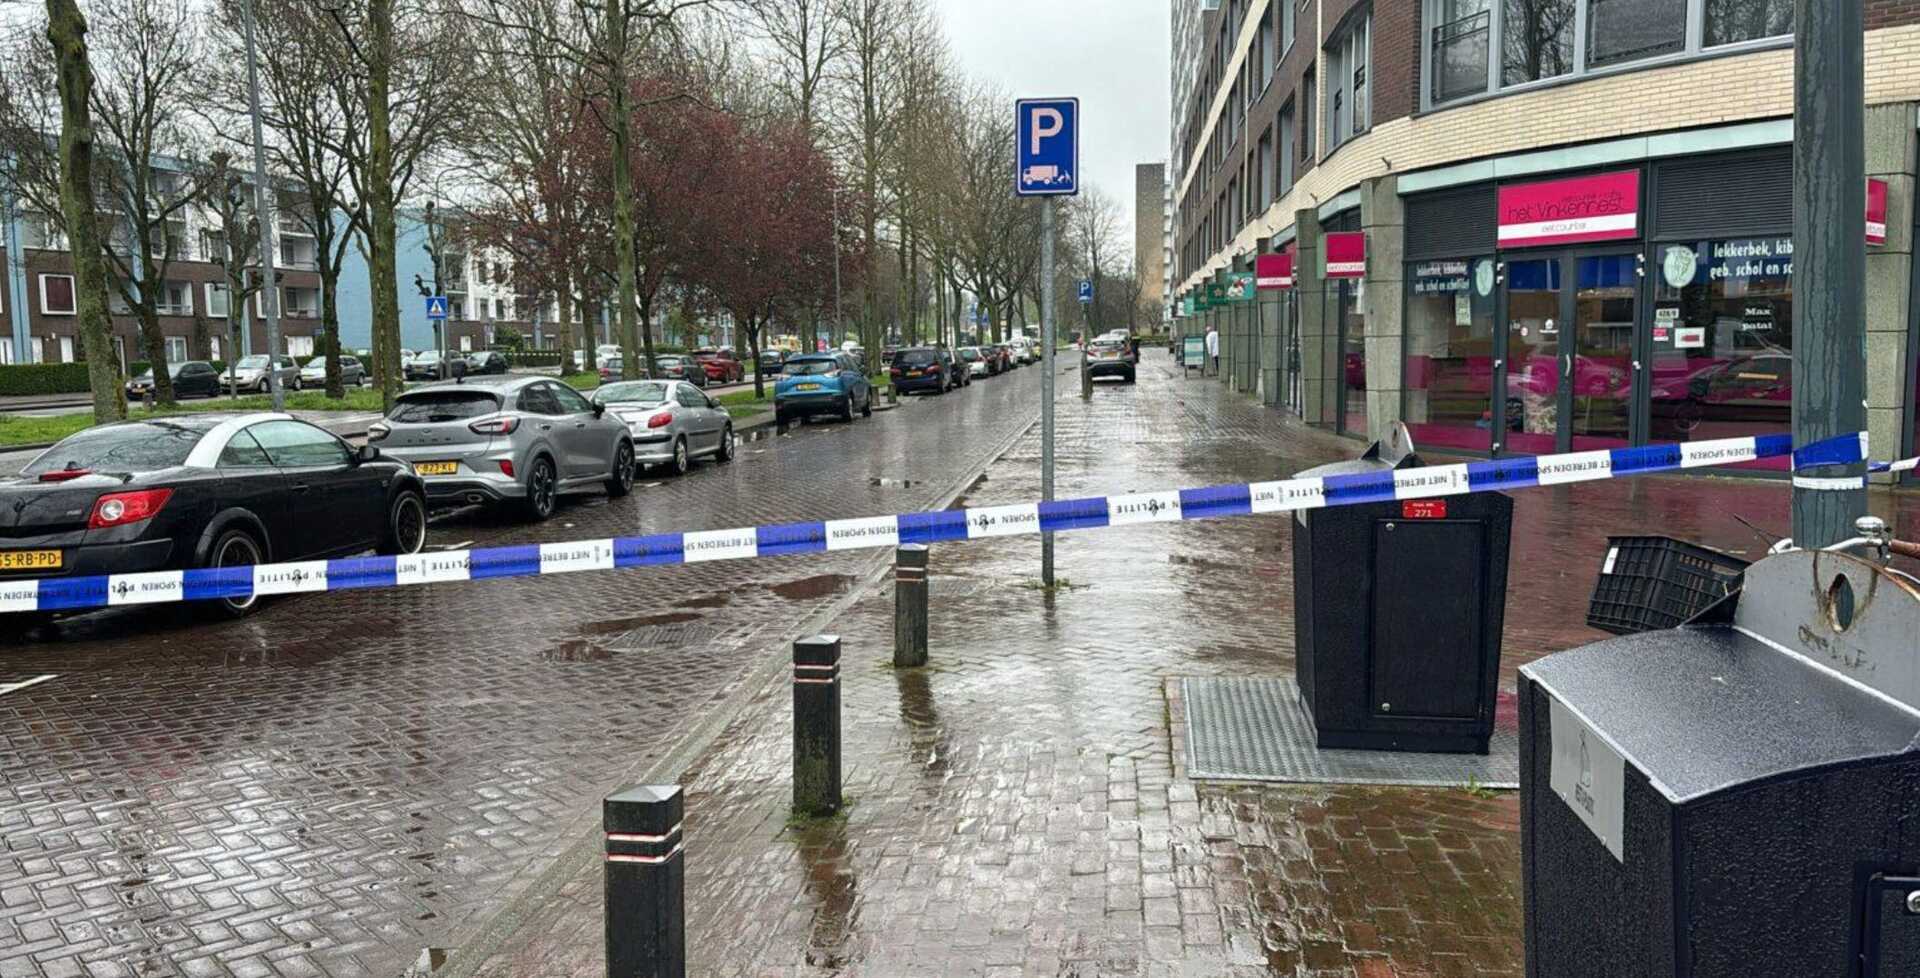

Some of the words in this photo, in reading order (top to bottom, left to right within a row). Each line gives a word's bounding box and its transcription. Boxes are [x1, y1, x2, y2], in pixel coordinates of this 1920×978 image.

[1031, 108, 1064, 155] P
[1709, 262, 1732, 280] geb.
[1736, 258, 1763, 276] schol
[1766, 263, 1780, 275] en
[1080, 282, 1089, 294] P
[1690, 450, 1727, 460] SPOREN
[1553, 461, 1598, 473] BETREDEN
[1428, 476, 1448, 485] NIET
[1255, 491, 1274, 501] NIET
[1002, 513, 1035, 524] SPOREN
[1414, 509, 1432, 518] 271
[832, 528, 867, 538] SPOREN
[697, 538, 741, 549] BETREDEN
[571, 551, 590, 560] NIET
[398, 564, 416, 573] NIET
[142, 581, 176, 592] SPOREN
